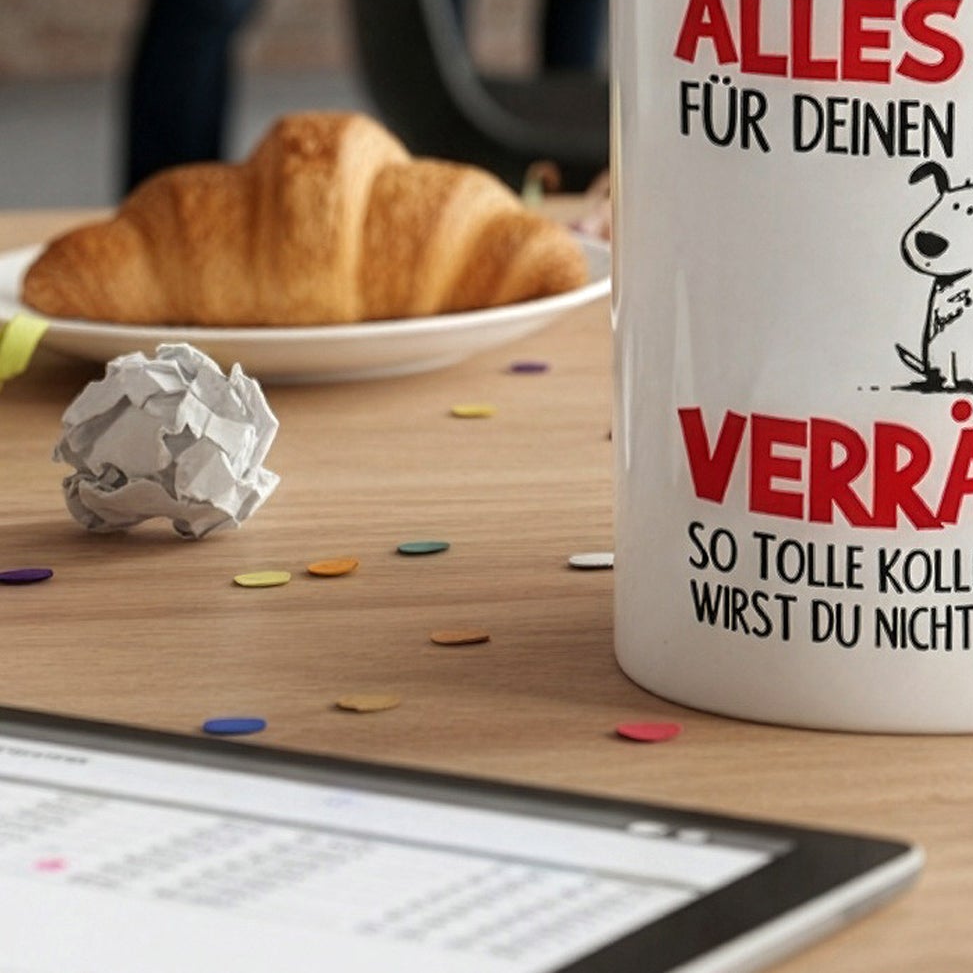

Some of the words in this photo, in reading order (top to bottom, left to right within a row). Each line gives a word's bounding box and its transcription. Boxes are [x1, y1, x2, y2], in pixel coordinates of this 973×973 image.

[679, 73, 771, 154] FÜR
[792, 93, 955, 159] DEINEN
[687, 520, 738, 574] SO
[752, 530, 864, 590] TOLLE
[689, 578, 798, 642] WIRST
[811, 598, 861, 649] DU
